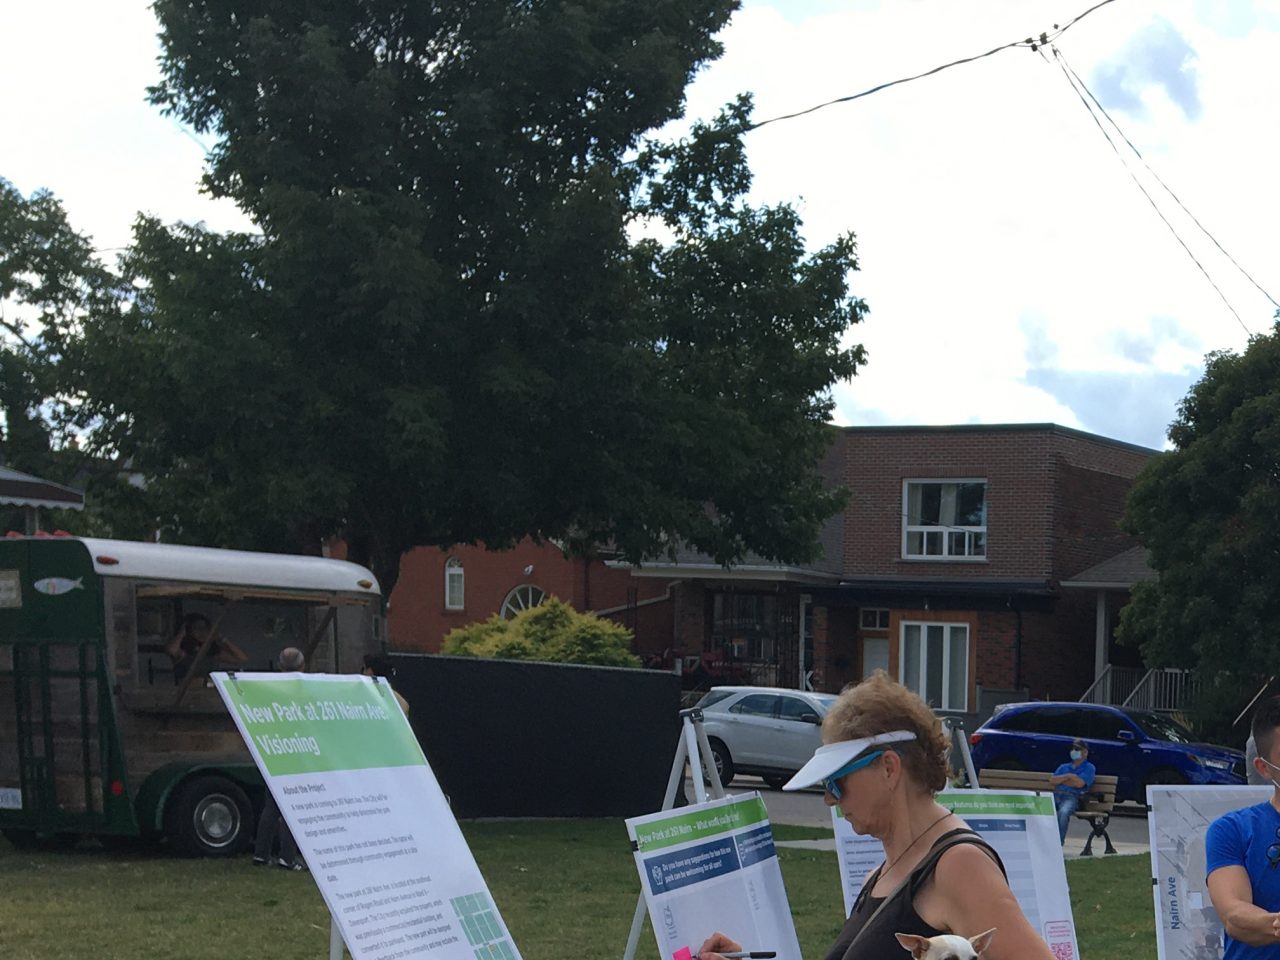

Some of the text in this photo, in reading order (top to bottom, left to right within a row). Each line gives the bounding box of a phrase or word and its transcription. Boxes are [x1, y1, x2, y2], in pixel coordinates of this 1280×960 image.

[239, 704, 275, 723] New
[272, 702, 306, 721] Park
[304, 703, 319, 720] at
[317, 701, 339, 720] 261
[336, 701, 368, 719] Nairn
[256, 733, 320, 755] Visioning
[283, 786, 299, 795] About
[307, 784, 326, 792] Project
[1168, 877, 1180, 930] Nairn Ave
